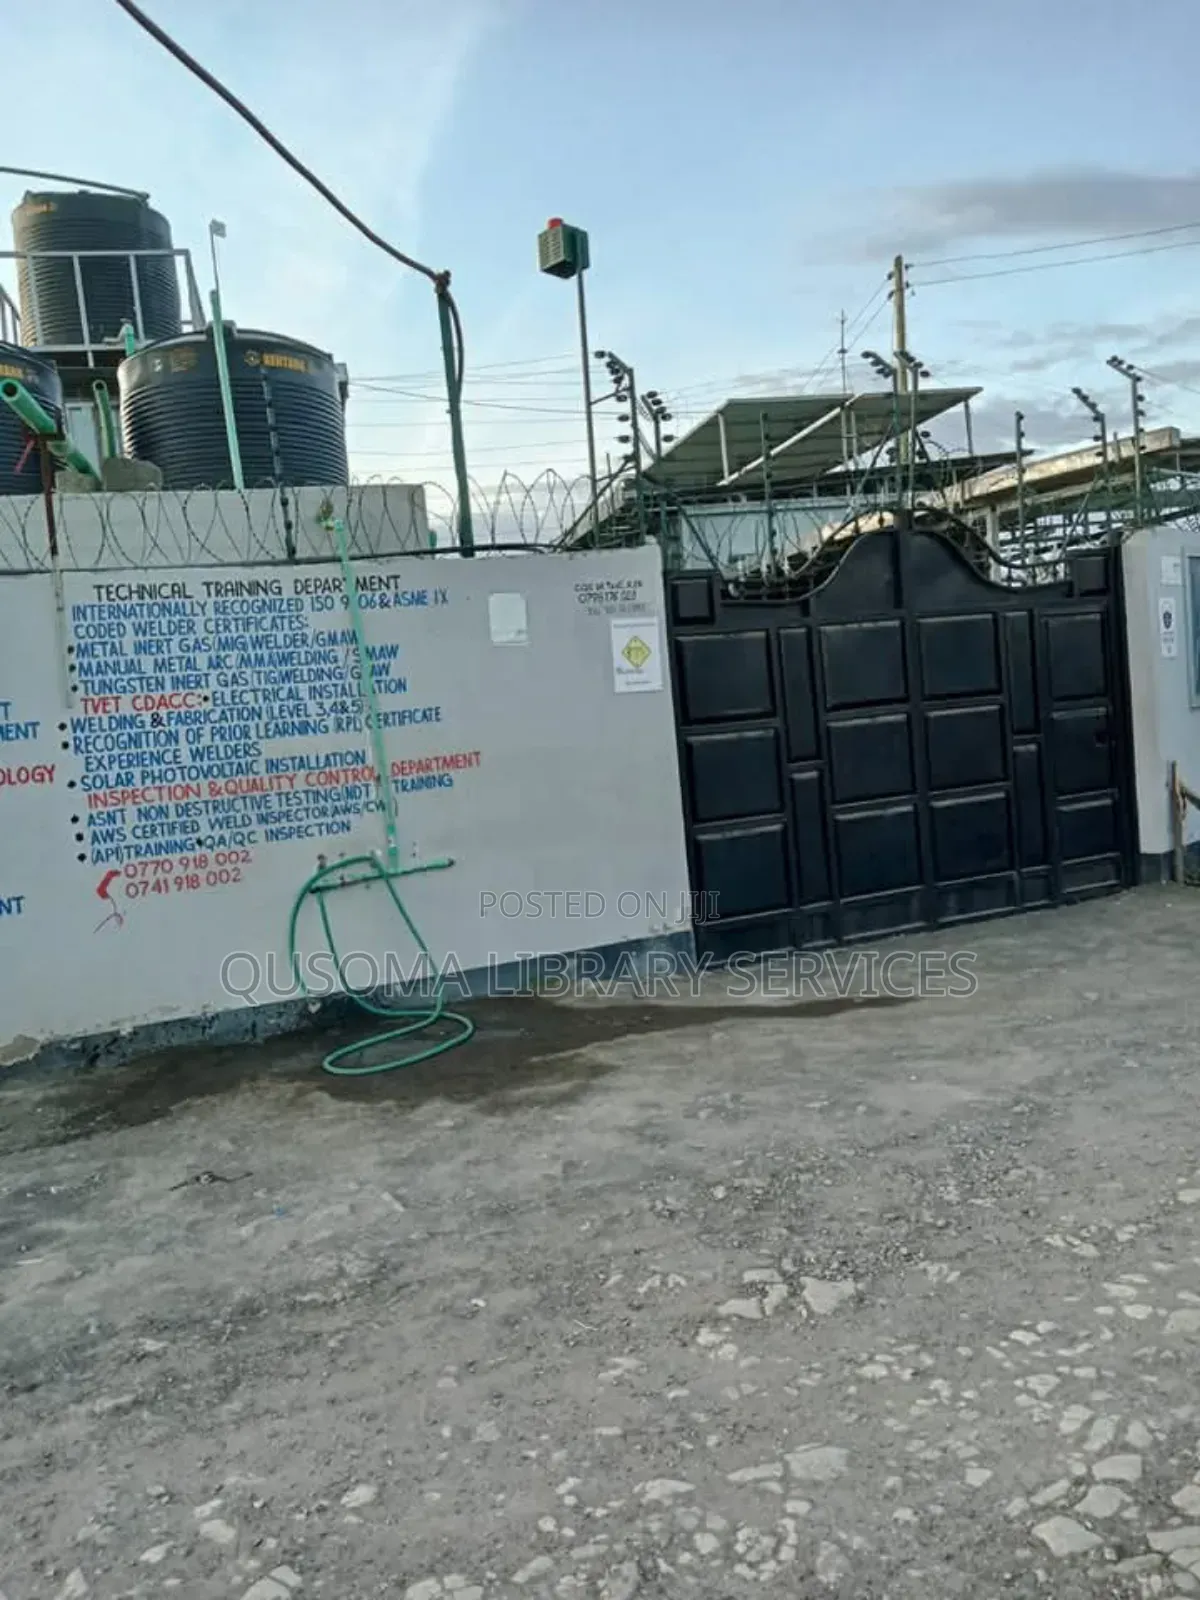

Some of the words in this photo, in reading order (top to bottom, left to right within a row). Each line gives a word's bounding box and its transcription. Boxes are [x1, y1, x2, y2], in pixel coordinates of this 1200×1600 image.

[93, 582, 194, 602] TECHNICAL
[203, 578, 283, 599] TRAINING
[294, 574, 400, 595] DEPARMENT
[72, 601, 208, 622] INTERNATIONALLY
[213, 598, 304, 616] RECOGNIZED
[310, 594, 335, 613] ISO
[74, 622, 127, 640] CODED
[132, 618, 196, 637] WELDER
[76, 640, 128, 659] METAL
[133, 638, 174, 656] INERT
[78, 659, 146, 678] MANUAL
[153, 655, 200, 673] METAL
[207, 652, 234, 670] ARC
[80, 676, 165, 696] TUNGSTEN
[171, 672, 211, 690] INERT
[216, 669, 249, 688] GAS
[211, 686, 304, 708] ELECTRICAL
[80, 698, 121, 715] TVET
[70, 712, 146, 735] WELDING
[73, 729, 179, 756] RECOGNITION
[185, 726, 205, 745] OF
[211, 722, 252, 742] PRIOR
[255, 718, 330, 740] LEARNING
[80, 772, 135, 792] SOLAR
[141, 759, 261, 786] PHOTOVOLTAIC
[265, 750, 366, 774] INSTALLATION
[85, 748, 182, 773] EXPERIENCE
[190, 742, 262, 764] WELDERS
[87, 783, 201, 809] INSPECTION
[391, 751, 481, 778] DEPARTMENT
[87, 808, 127, 828] ASNT
[137, 804, 169, 820] NON
[177, 794, 273, 817] DESTRUCTIVE
[391, 773, 454, 794] TRAINING
[91, 826, 127, 846] AWS
[132, 819, 200, 840] CERTIFIED
[208, 814, 253, 832] WELD
[204, 830, 258, 851] QA/QC
[264, 819, 352, 843] INSPECTION
[124, 860, 174, 878] 0770
[179, 855, 209, 872] 918
[214, 848, 252, 866] 002
[125, 879, 170, 898] 0741
[174, 874, 200, 892] 918
[206, 867, 242, 886] 002
